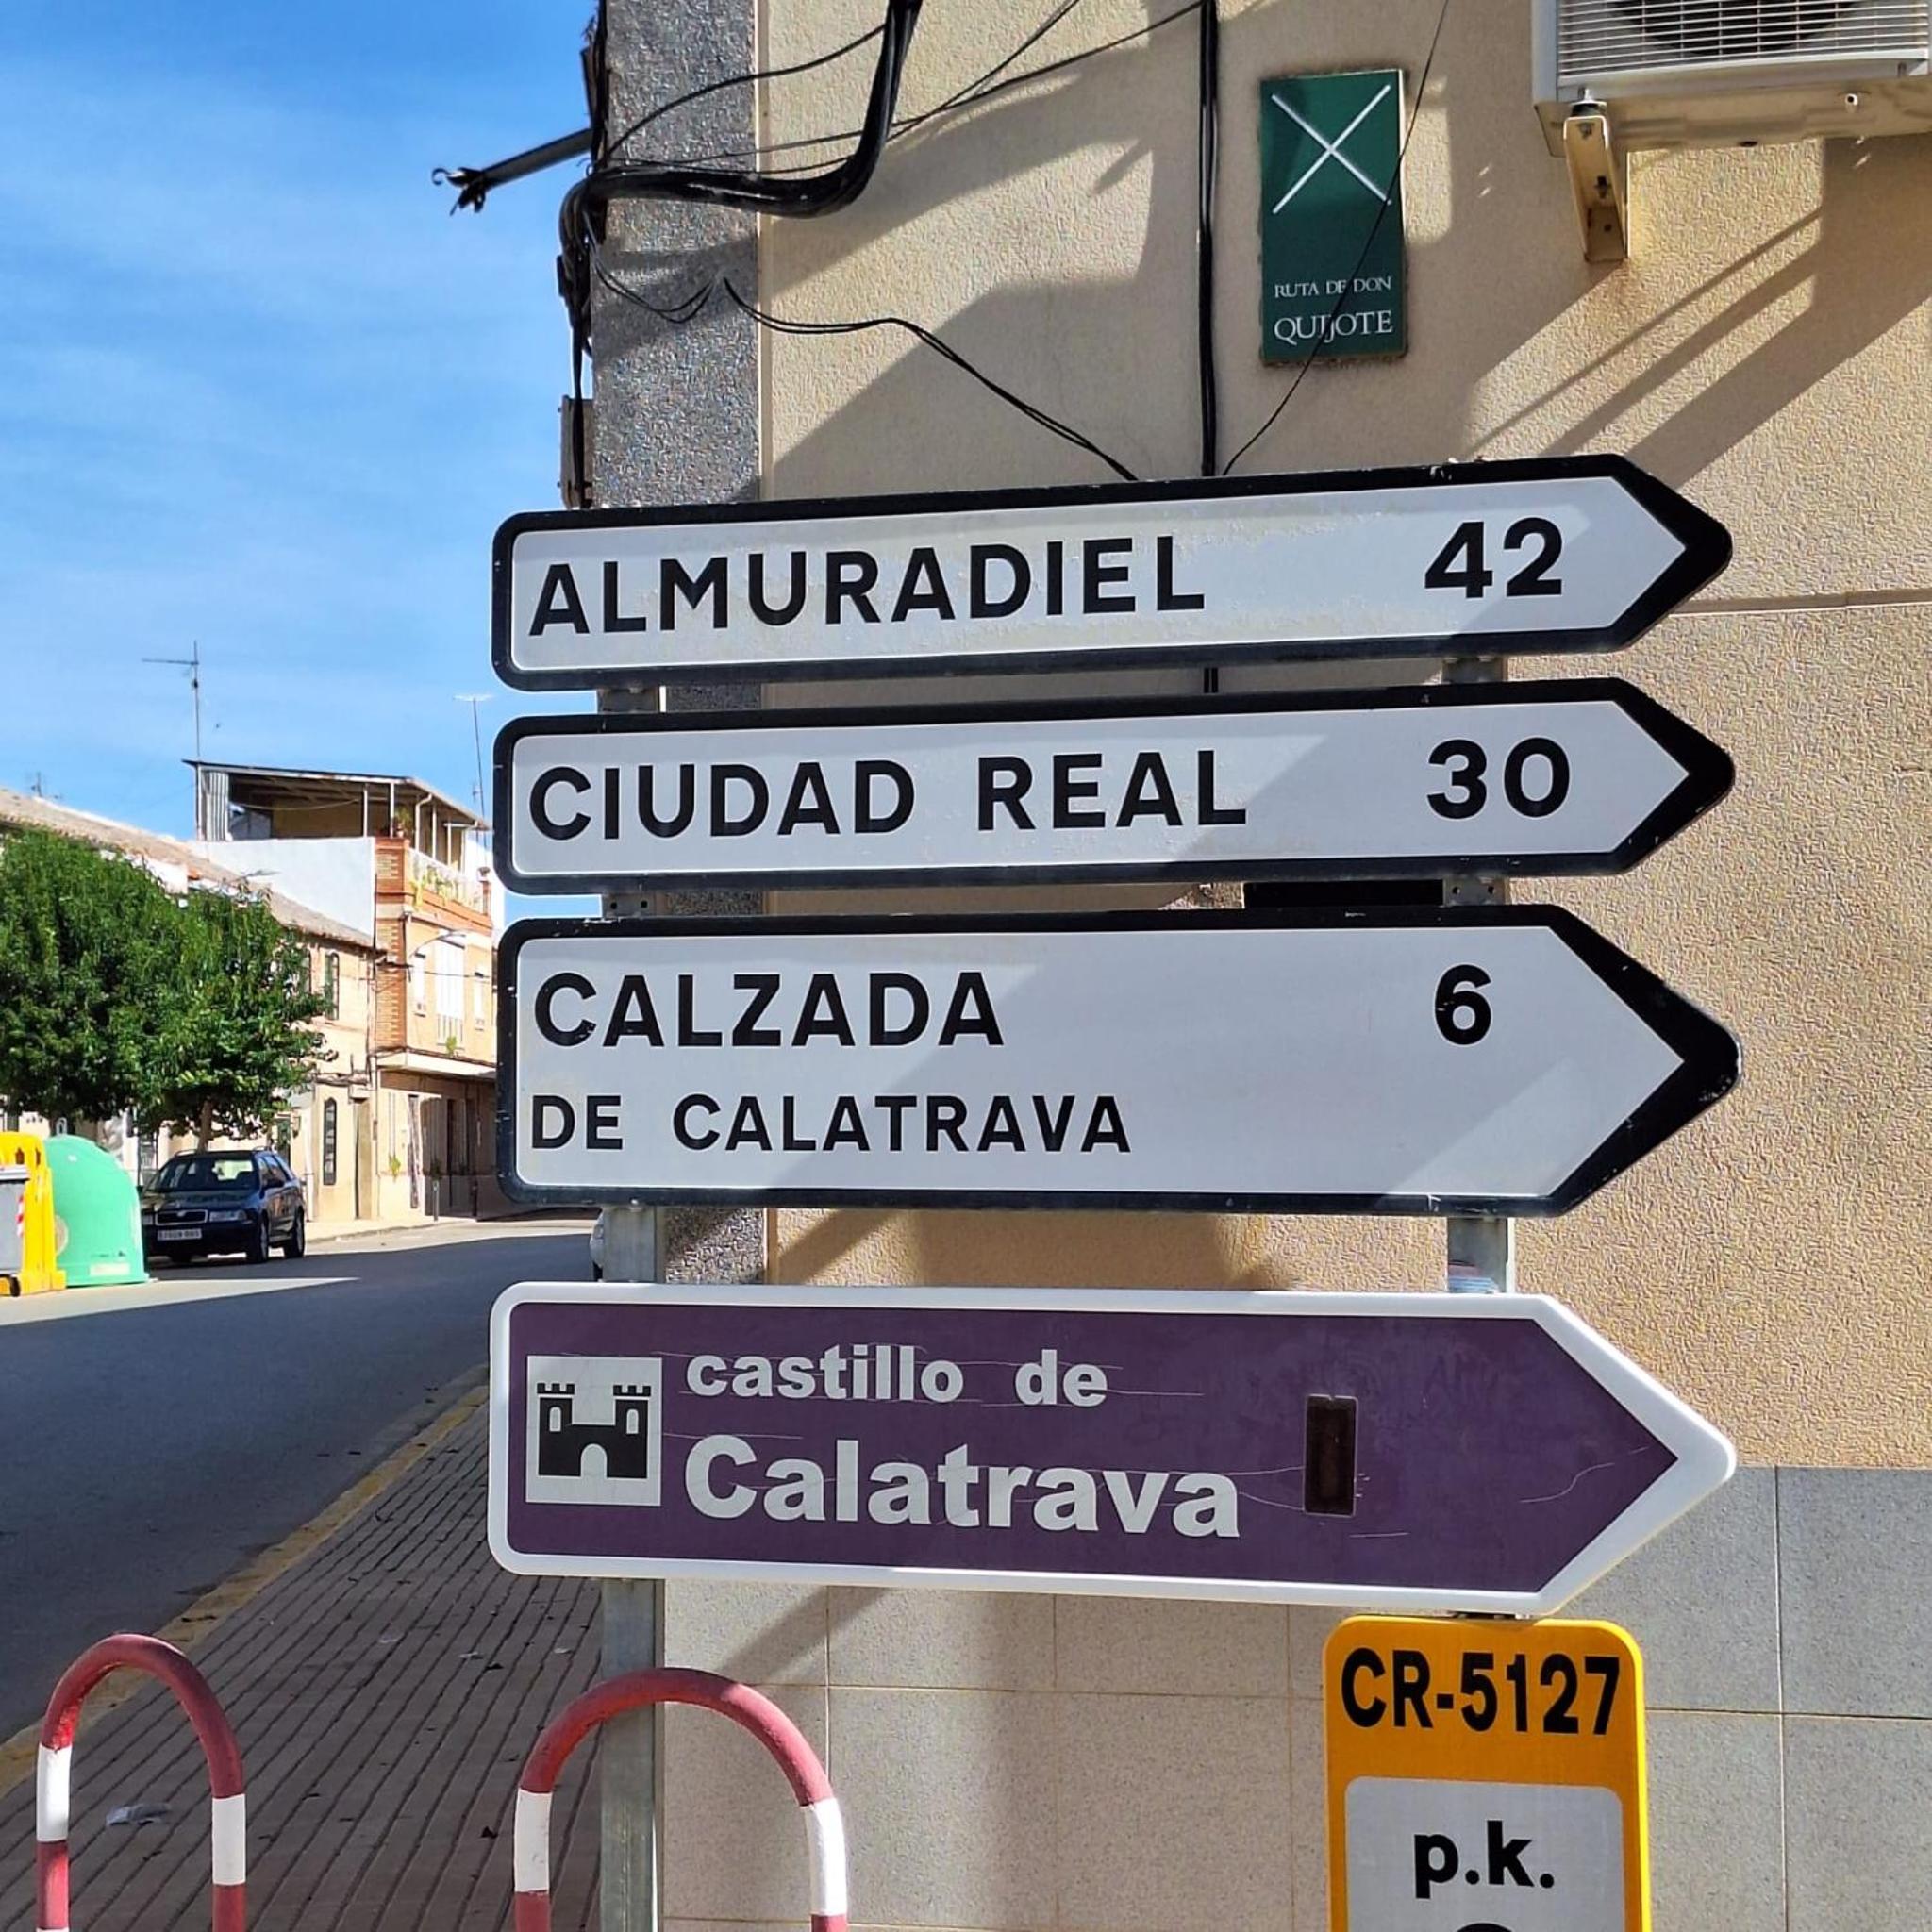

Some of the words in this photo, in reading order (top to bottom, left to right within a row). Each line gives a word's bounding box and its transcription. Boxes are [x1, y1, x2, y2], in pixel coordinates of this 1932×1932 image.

[1274, 310, 1393, 345] QUIJOTE
[1275, 282, 1320, 299] RUTA
[1326, 279, 1348, 295] DE
[1354, 276, 1392, 293] DON
[528, 535, 1205, 636] ALMURADIEL
[1424, 517, 1563, 599] 42
[529, 759, 915, 841] CIUDAD
[978, 750, 1247, 831] REAL
[1426, 737, 1570, 820] 30
[534, 971, 1005, 1047] CALZADA
[1434, 964, 1491, 1045] 6
[531, 1094, 624, 1151] DE
[673, 1093, 1131, 1153] CALATRAVA
[686, 1344, 964, 1403] castillo
[1015, 1349, 1108, 1407] de
[685, 1434, 1241, 1538] Calatrava
[1341, 1647, 1621, 1736] CR-5127
[1413, 1820, 1555, 1900] p.k.
